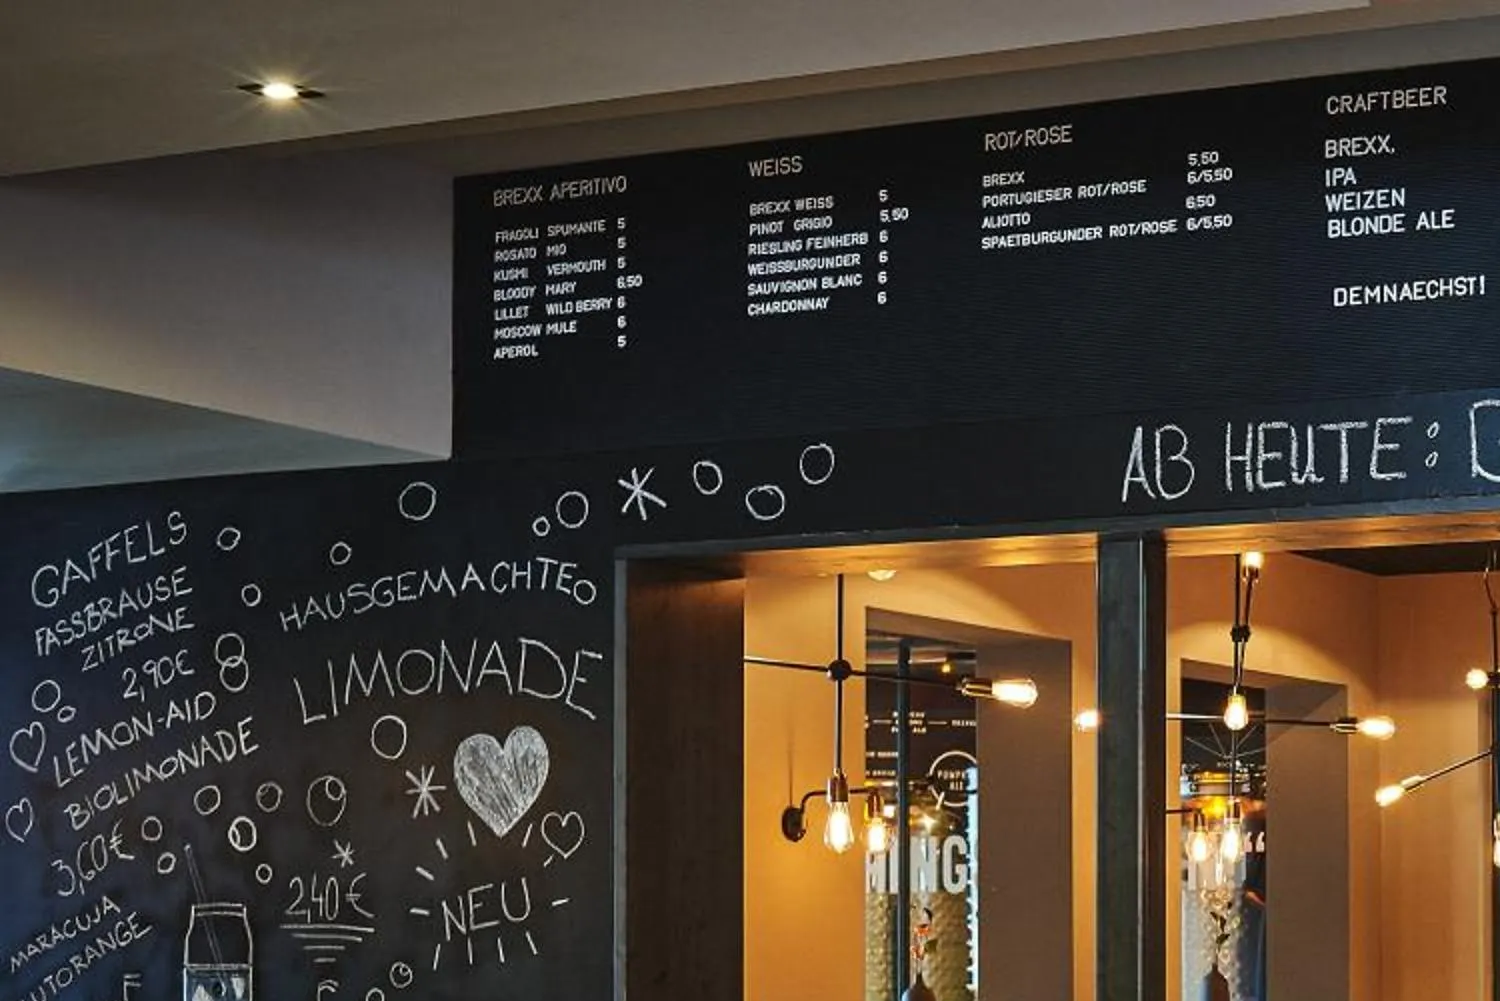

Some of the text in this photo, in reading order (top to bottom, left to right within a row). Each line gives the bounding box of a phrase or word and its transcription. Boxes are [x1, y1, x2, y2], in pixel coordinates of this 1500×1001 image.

[1327, 85, 1447, 115] CRAFTBEER
[985, 124, 1073, 151] ROT/ROSE
[748, 155, 803, 177] WEISS
[983, 171, 1025, 188] BREXX
[1325, 167, 1357, 187] IPA
[493, 175, 627, 206] BREXX APERITIVO
[749, 189, 888, 216] BREXX WEISS 5
[982, 187, 1072, 208] PORTUGIESER
[1077, 179, 1147, 199] ROT/ROSE
[1325, 187, 1405, 212] WEIZEN
[495, 217, 626, 243] FRAGOLI SPUMANTE 5
[749, 220, 784, 236] PINOT
[793, 216, 833, 231] GRIGIO
[981, 226, 1103, 249] SPAETBURGUNDER
[1109, 219, 1178, 238] ROT/ROSE
[1327, 209, 1455, 239] BLONDE ALE
[495, 237, 626, 262] ROSATO MIO 5
[748, 229, 888, 255] RIESLING FEINHERB 6
[547, 258, 606, 276] VERMOUTH
[617, 257, 626, 269] 5
[747, 250, 888, 276] WEISSBURGUNDER 6
[493, 285, 536, 301] BLOODY
[545, 281, 576, 296] MARY
[747, 271, 887, 296] SAUVIGNON BLANC 6
[1333, 275, 1486, 307] DEMNAECHST!
[495, 296, 626, 321] LILLET WILD BERRY 6
[747, 291, 887, 316] CHARDONNAY 6
[494, 315, 627, 340] MOSCOW MULE 6
[494, 335, 626, 360] APEROL 5
[1121, 424, 1195, 503] AB
[31, 511, 188, 608] GAFFELS
[279, 556, 577, 632] HAUSGEMACHTE
[81, 607, 195, 672] ZITRONE
[293, 637, 603, 724] LIMONADE
[53, 691, 216, 788] LEMON-AID
[63, 716, 259, 831] BIOLIMONADE
[441, 877, 531, 941] NEU
[10, 895, 121, 973] MARACUJA
